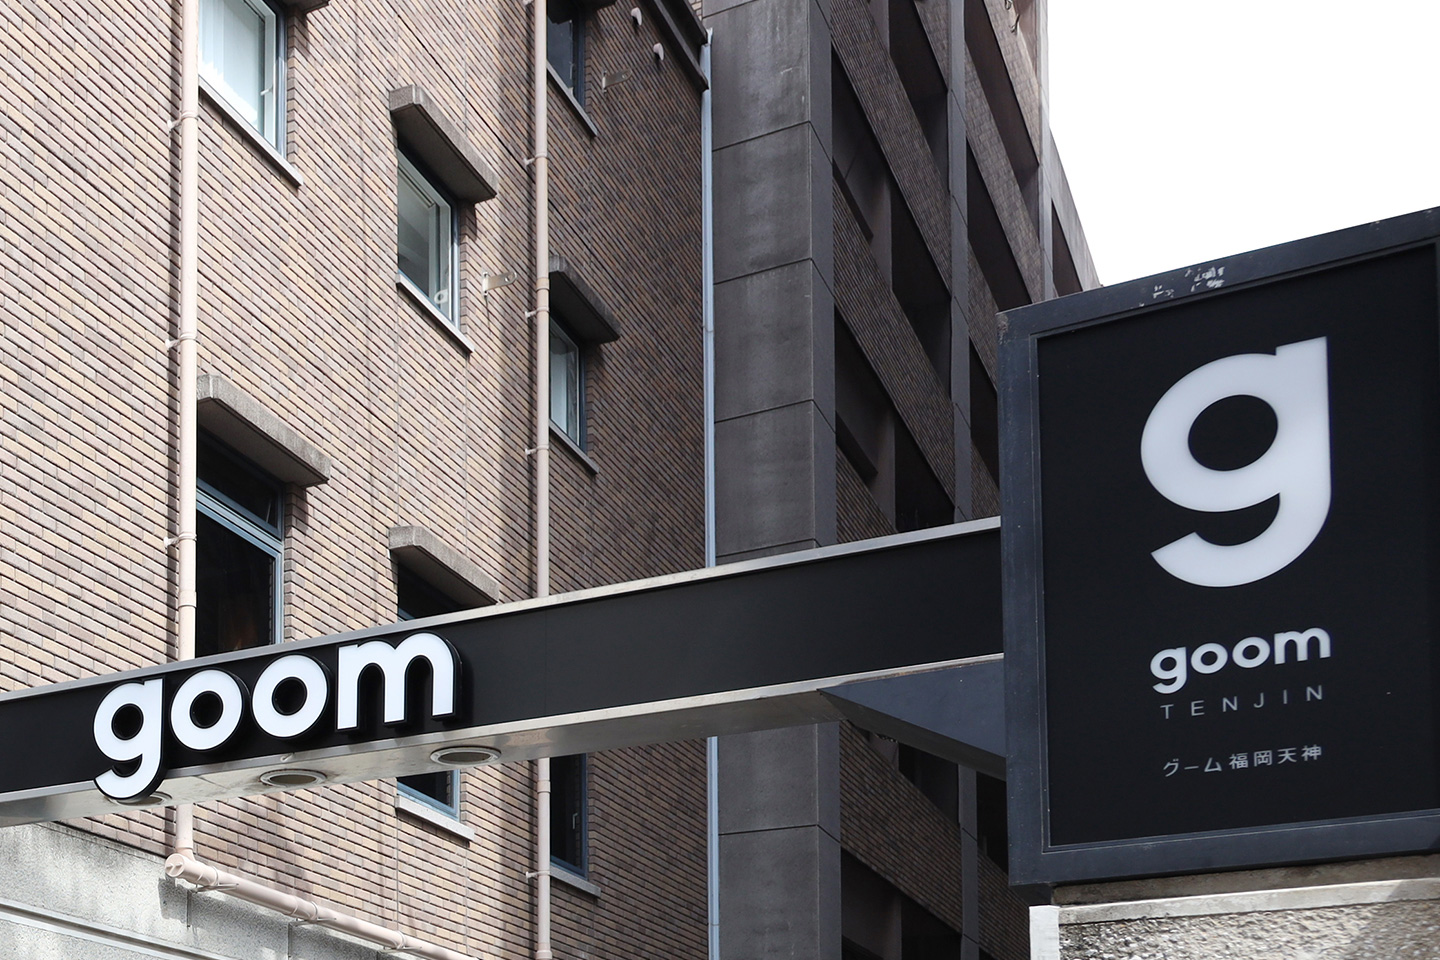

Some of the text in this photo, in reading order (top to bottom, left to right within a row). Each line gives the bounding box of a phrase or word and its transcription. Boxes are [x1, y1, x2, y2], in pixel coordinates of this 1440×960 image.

[1140, 335, 1332, 588] g
[1149, 627, 1332, 695] goom
[93, 632, 455, 799] goom
[1160, 684, 1323, 720] TENJIN
[1162, 743, 1323, 778] グーム福岡天神
